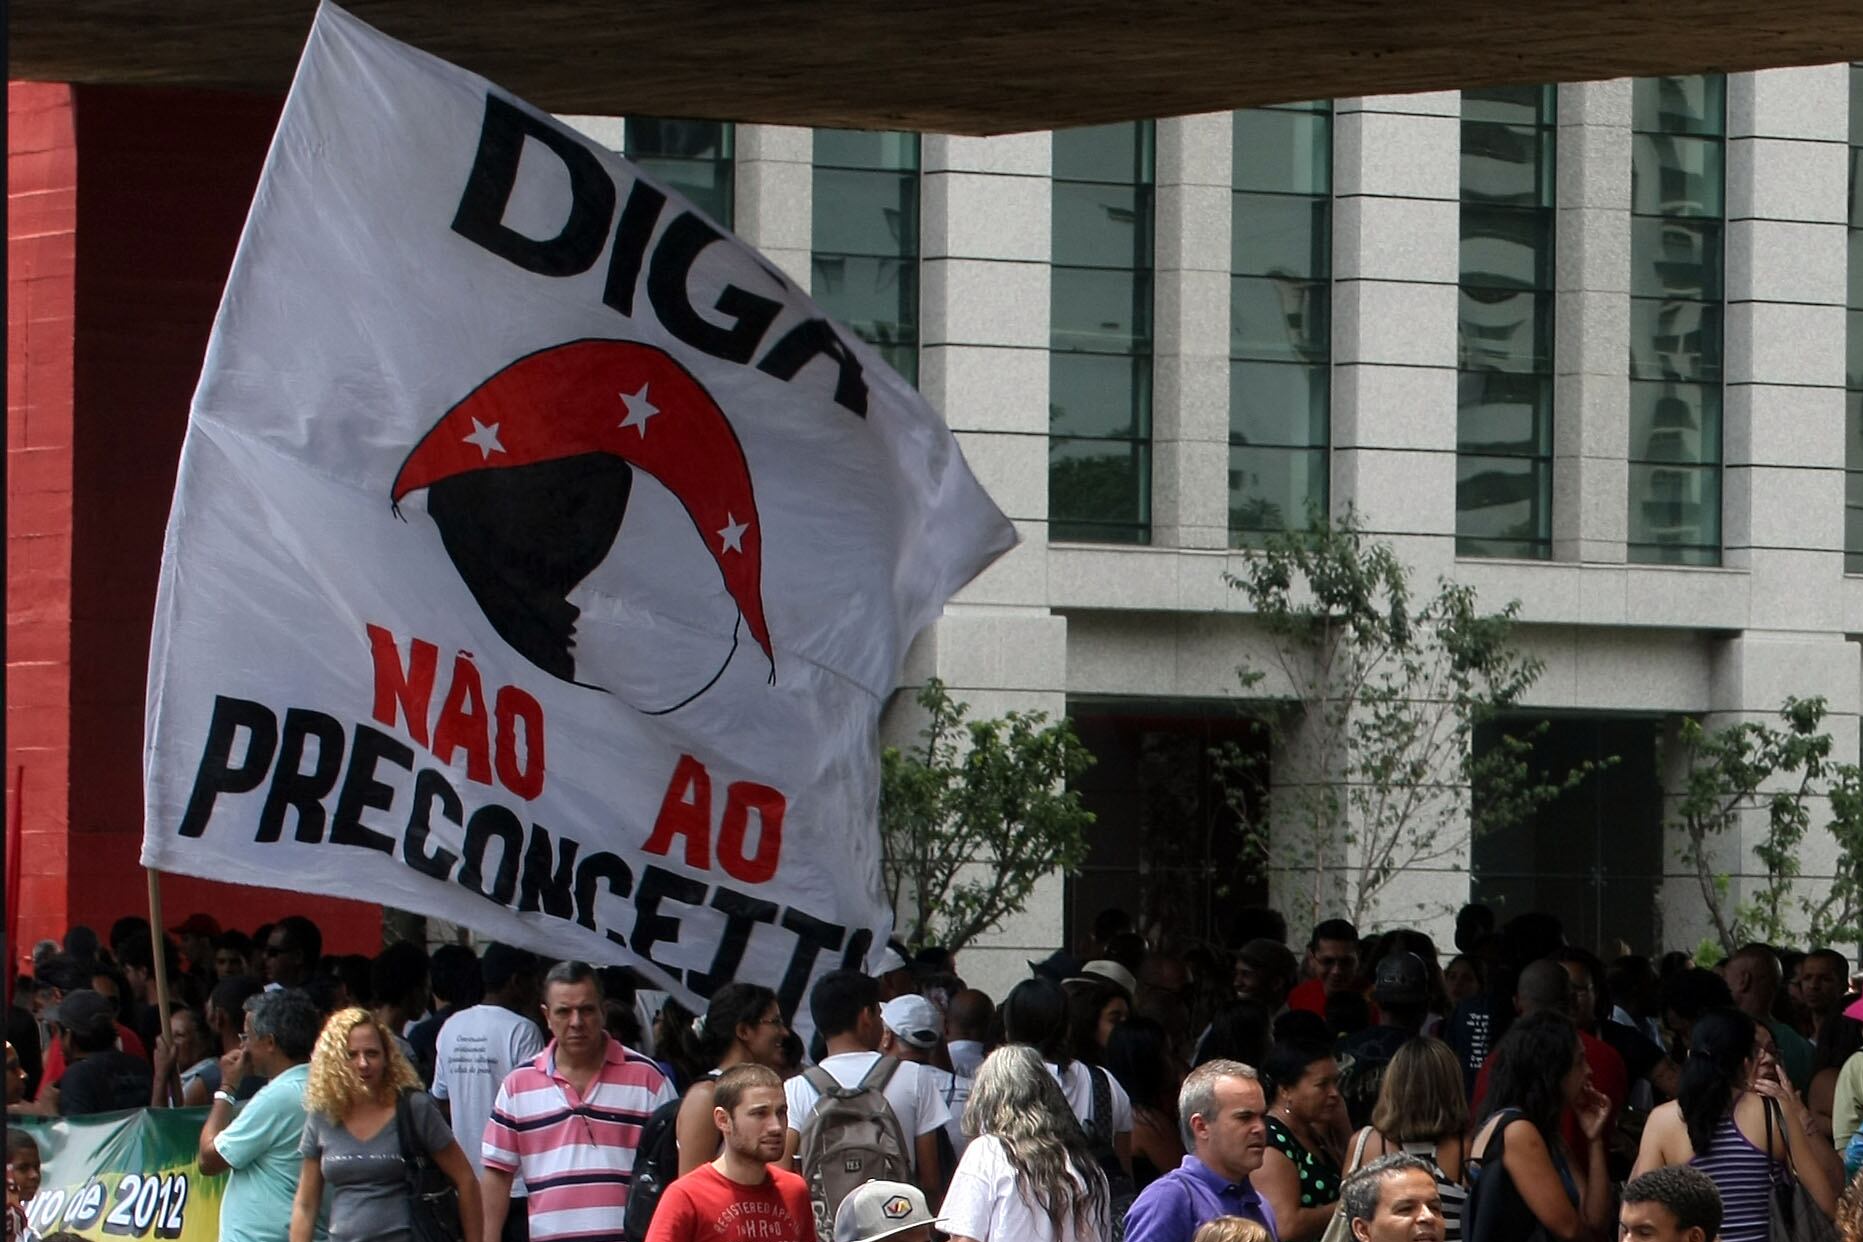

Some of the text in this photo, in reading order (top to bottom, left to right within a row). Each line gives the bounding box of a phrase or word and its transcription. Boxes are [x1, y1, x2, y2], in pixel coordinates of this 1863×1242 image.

[451, 92, 869, 420] DIGA
[366, 623, 786, 886] NÃO AO
[64, 1178, 102, 1223] de
[106, 1174, 187, 1230] 2012
[713, 1201, 770, 1234] REGISTERED
